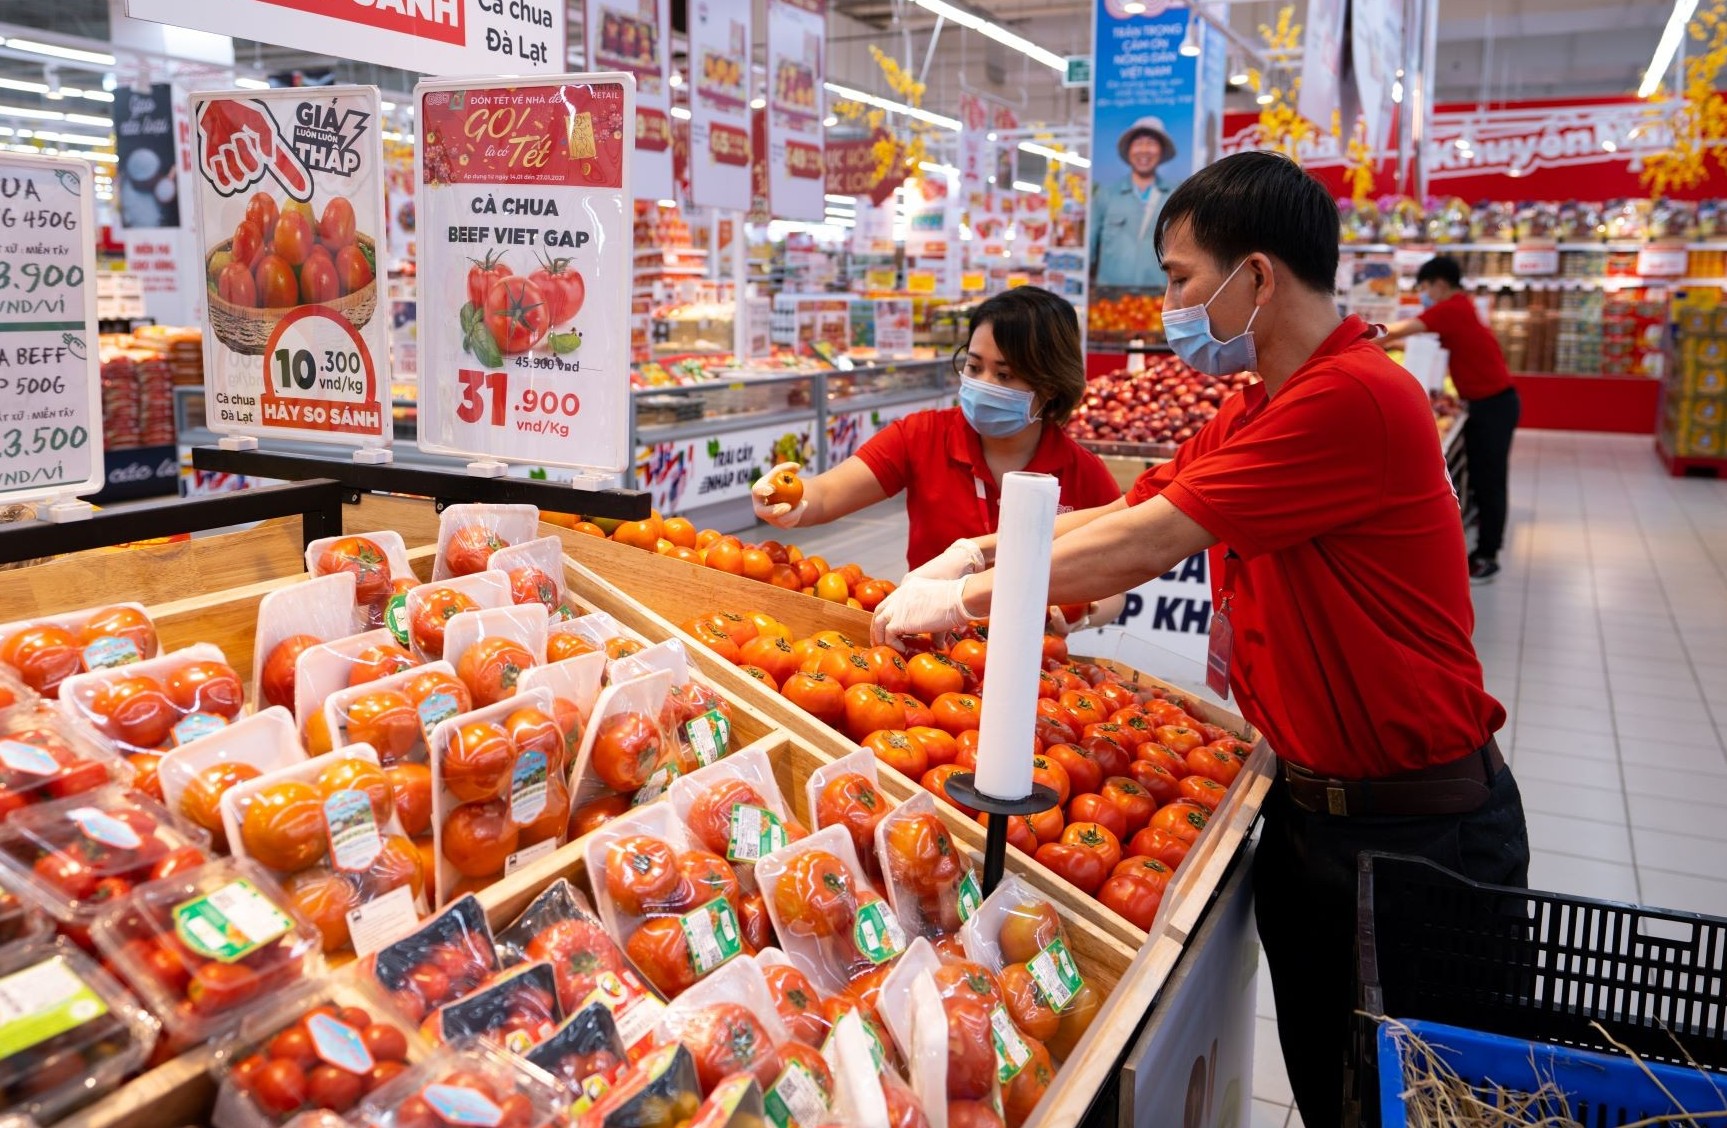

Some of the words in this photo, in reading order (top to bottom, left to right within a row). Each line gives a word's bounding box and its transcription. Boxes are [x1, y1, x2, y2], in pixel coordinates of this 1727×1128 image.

[509, 0, 553, 28] chua
[486, 28, 512, 55] Đà
[519, 35, 548, 66] Lạt
[493, 94, 510, 104] TẾT
[525, 93, 546, 104] NHÀ
[592, 91, 620, 99] RETAIL
[296, 97, 341, 132] GIÁ
[464, 107, 530, 142] GO!
[296, 128, 317, 140] LUÔN
[317, 131, 339, 143] LUÔN
[508, 134, 552, 168] Tết
[471, 193, 497, 214] CÀ
[502, 197, 559, 216] CHUA
[23, 209, 77, 231] 450G
[448, 226, 489, 243] BEEF
[494, 227, 539, 245] VIET
[544, 230, 590, 248] GAP
[275, 349, 317, 390] 10
[320, 350, 361, 374] .300
[515, 356, 555, 371] 45.900
[16, 376, 66, 395] 500G
[319, 377, 363, 394] vnd/kg
[216, 392, 229, 404] Cà
[231, 394, 256, 406] chua
[456, 369, 508, 427] 31
[514, 389, 580, 417] .900
[221, 410, 234, 421] Đà
[237, 410, 254, 424] Lạt
[264, 400, 300, 421] HÃY
[303, 408, 327, 423] SO
[330, 406, 379, 428] SÁNH
[517, 420, 570, 438] vnd/Kg
[0, 425, 88, 458] 3.500
[1152, 596, 1212, 635] KH
